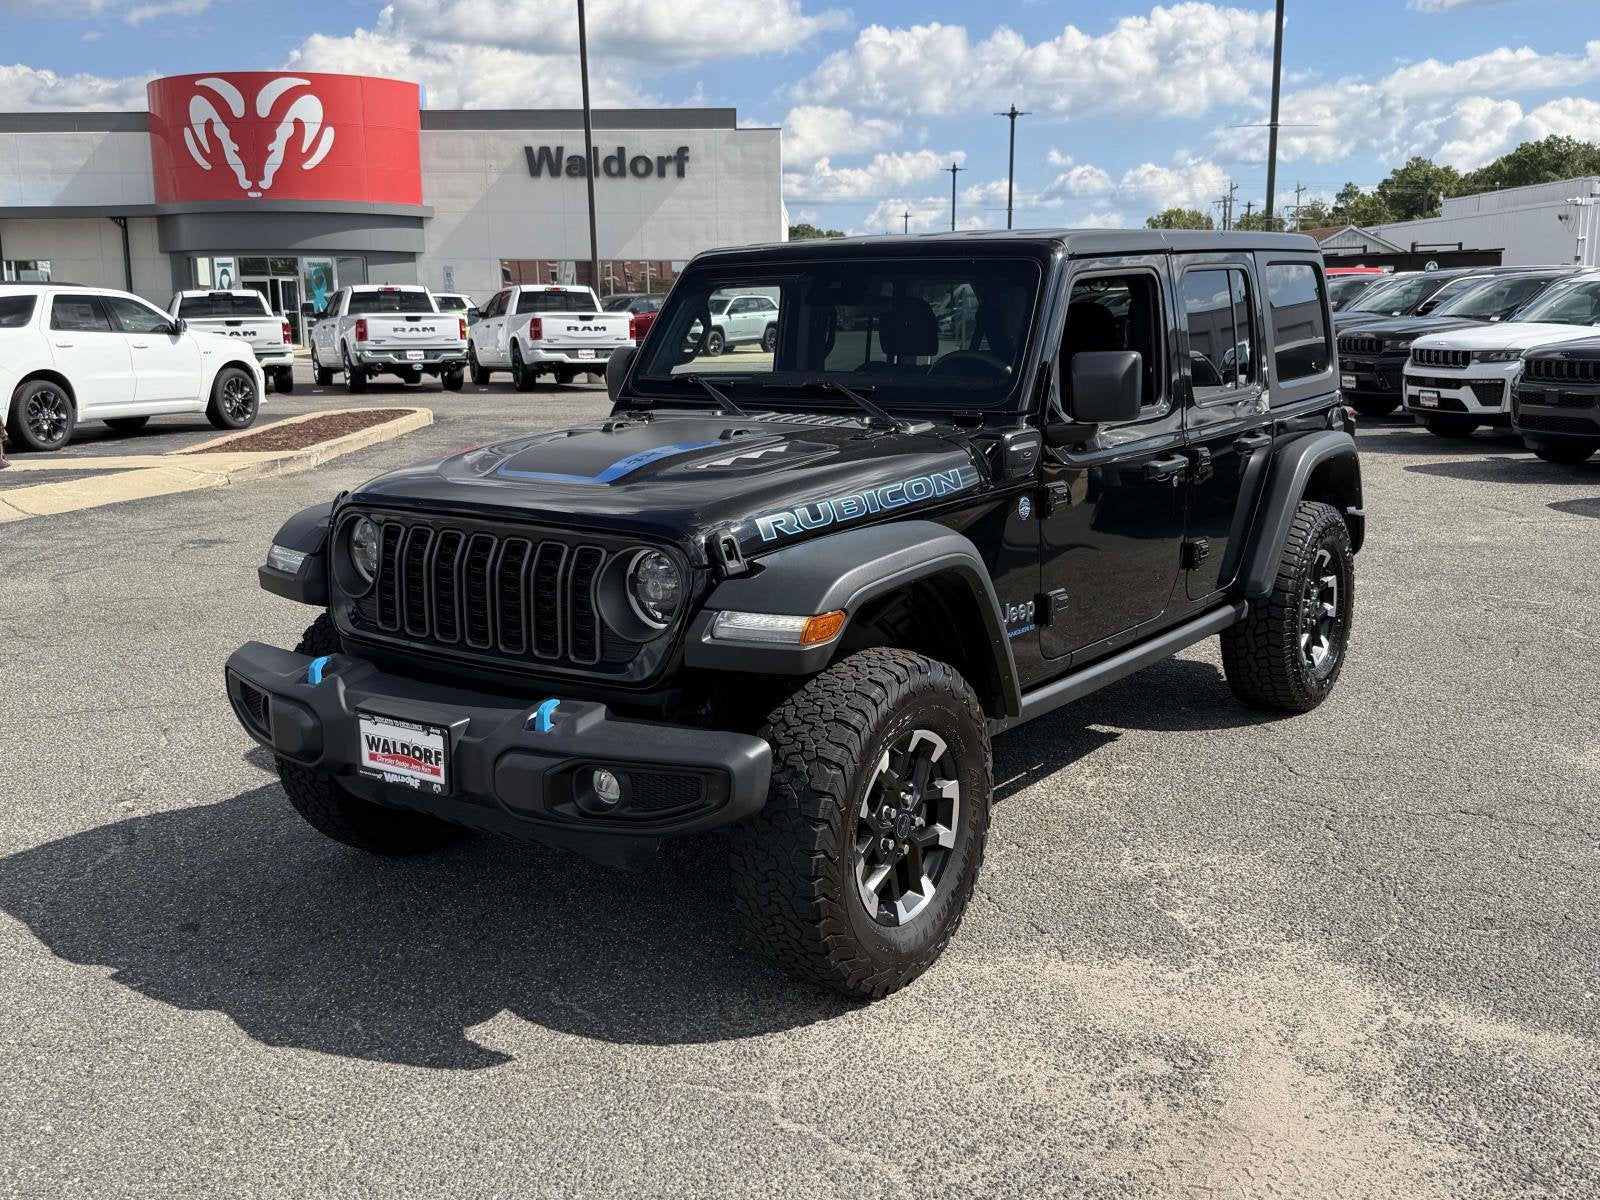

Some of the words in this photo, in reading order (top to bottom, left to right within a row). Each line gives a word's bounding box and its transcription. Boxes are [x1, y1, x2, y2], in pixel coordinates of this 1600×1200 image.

[524, 145, 690, 178] Waldorf
[755, 468, 963, 542] RUBICON
[1002, 600, 1036, 624] Jeep
[365, 734, 443, 766] WALDORF
[376, 755, 395, 766] Chrysler
[395, 759, 410, 769] Dodge
[410, 763, 420, 772] Jeep
[420, 766, 432, 774] Ram
[383, 771, 421, 789] WALDORF
